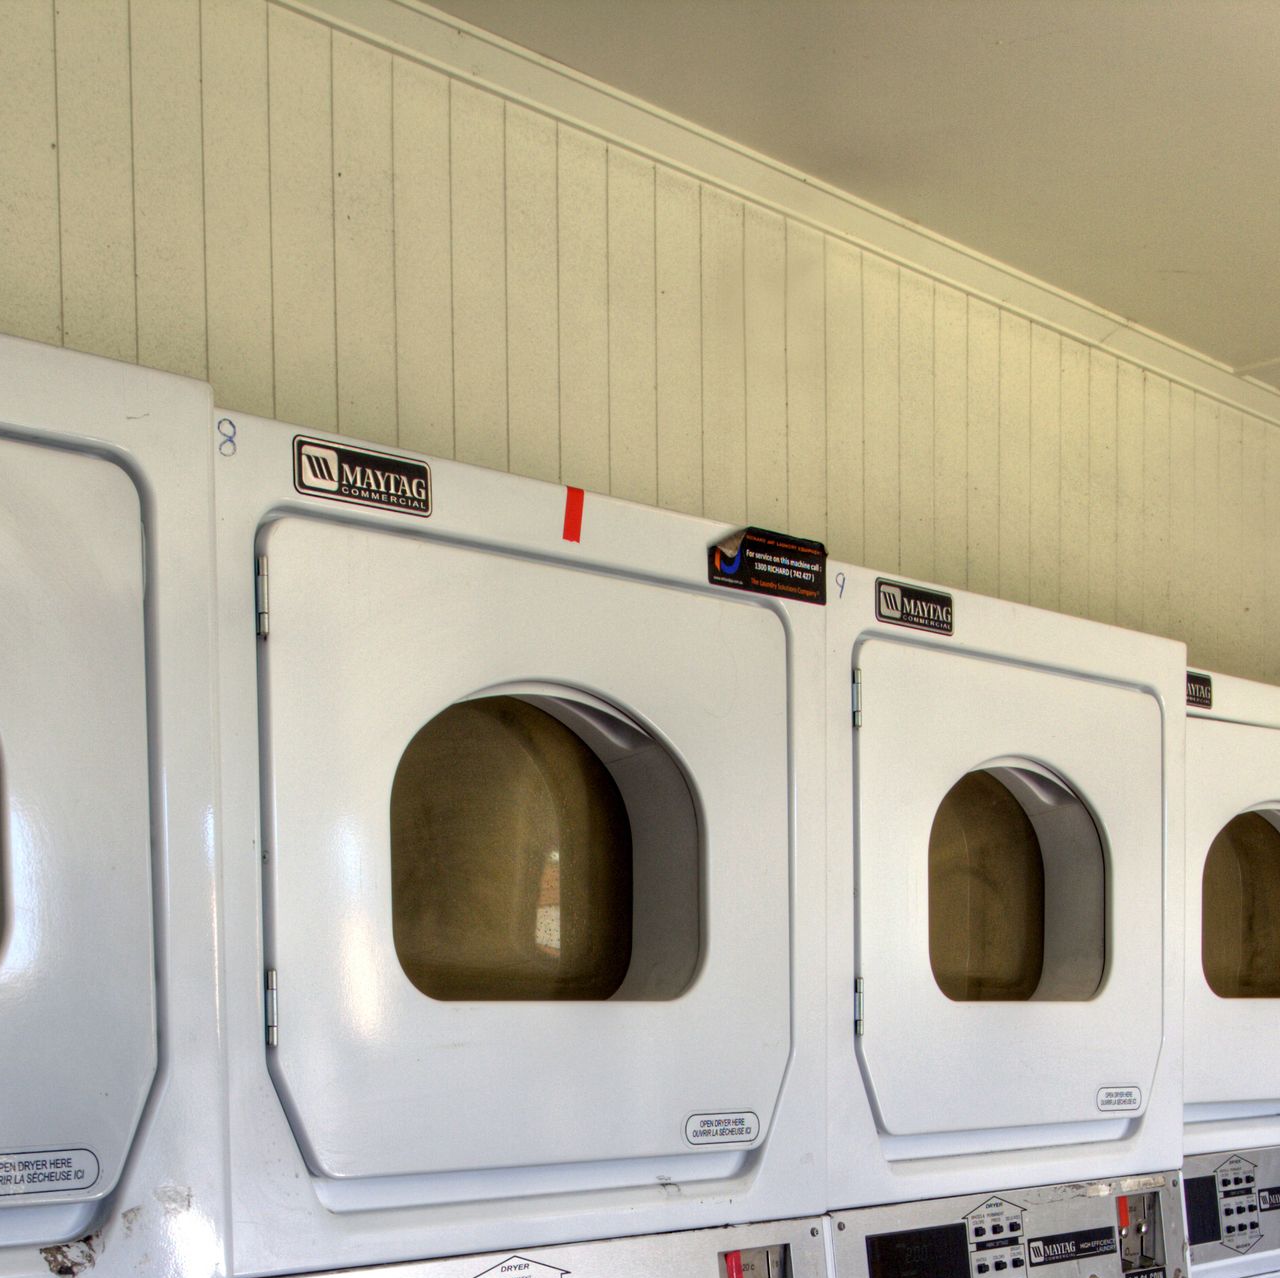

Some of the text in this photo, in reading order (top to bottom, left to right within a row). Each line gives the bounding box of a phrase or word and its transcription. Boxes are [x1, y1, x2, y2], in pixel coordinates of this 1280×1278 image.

[217, 418, 237, 457] 8
[341, 463, 426, 500] MAYTAG
[341, 486, 427, 510] COMMERCIAL
[902, 597, 952, 623] MAYTAG
[902, 613, 952, 630] COMMERCIAL
[17, 1159, 48, 1172] DRYER
[49, 1157, 73, 1169] HERE
[14, 1174, 25, 1184] LA
[26, 1169, 72, 1184] SÉCHEUSE
[73, 1169, 85, 1179] ICI
[1044, 1241, 1076, 1257] MAYTAG
[500, 1263, 530, 1273] DRYER
